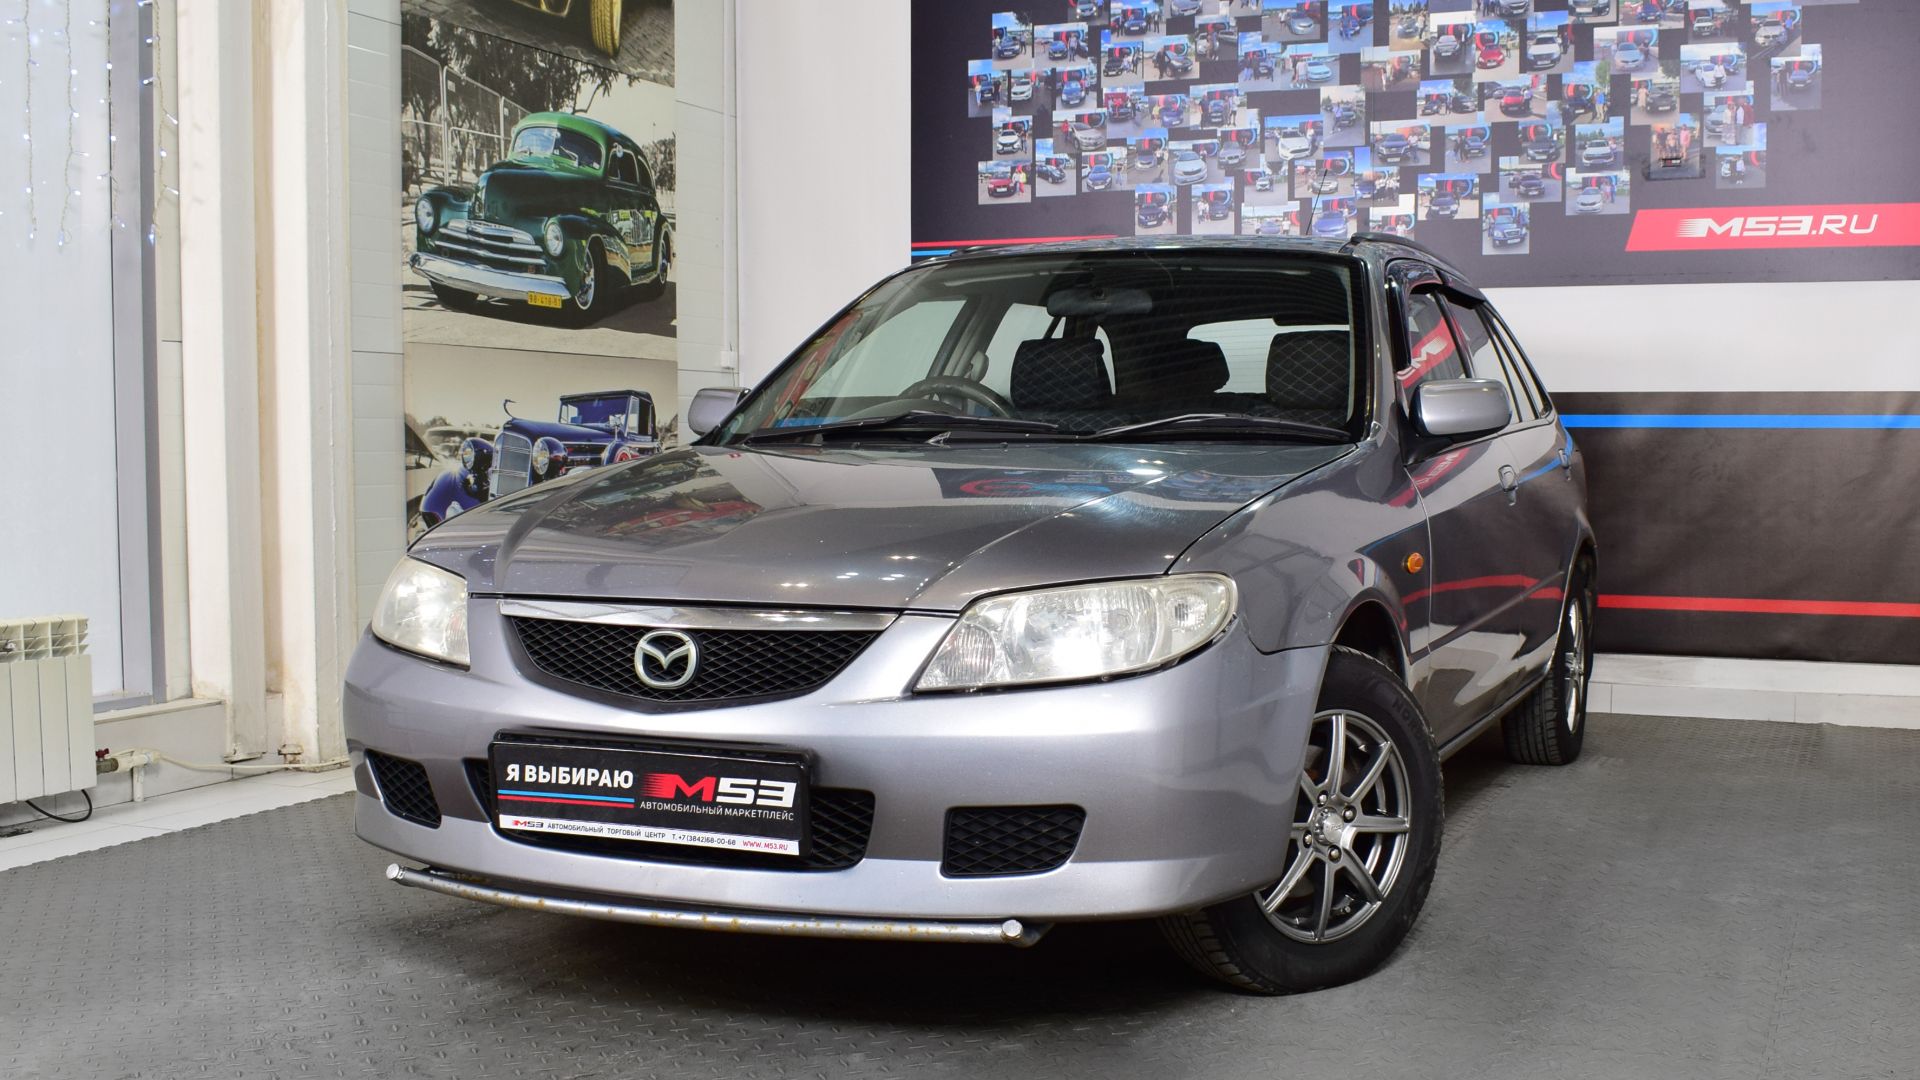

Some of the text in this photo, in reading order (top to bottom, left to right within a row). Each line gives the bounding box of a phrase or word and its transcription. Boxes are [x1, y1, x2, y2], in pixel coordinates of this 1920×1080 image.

[1676, 214, 1878, 237] M53.RU
[506, 763, 634, 789] Я ВЫБИРАЮ
[641, 772, 797, 808] M53
[640, 801, 794, 821] АВТОМОБИЛЬНЫЙ МАРКЕТПЛЕЙС
[547, 823, 604, 834] АВТОМОБИЛЬНЫЙ
[607, 827, 642, 837] ТОРГОВЫЙ
[644, 831, 666, 840] ЦЕНТР
